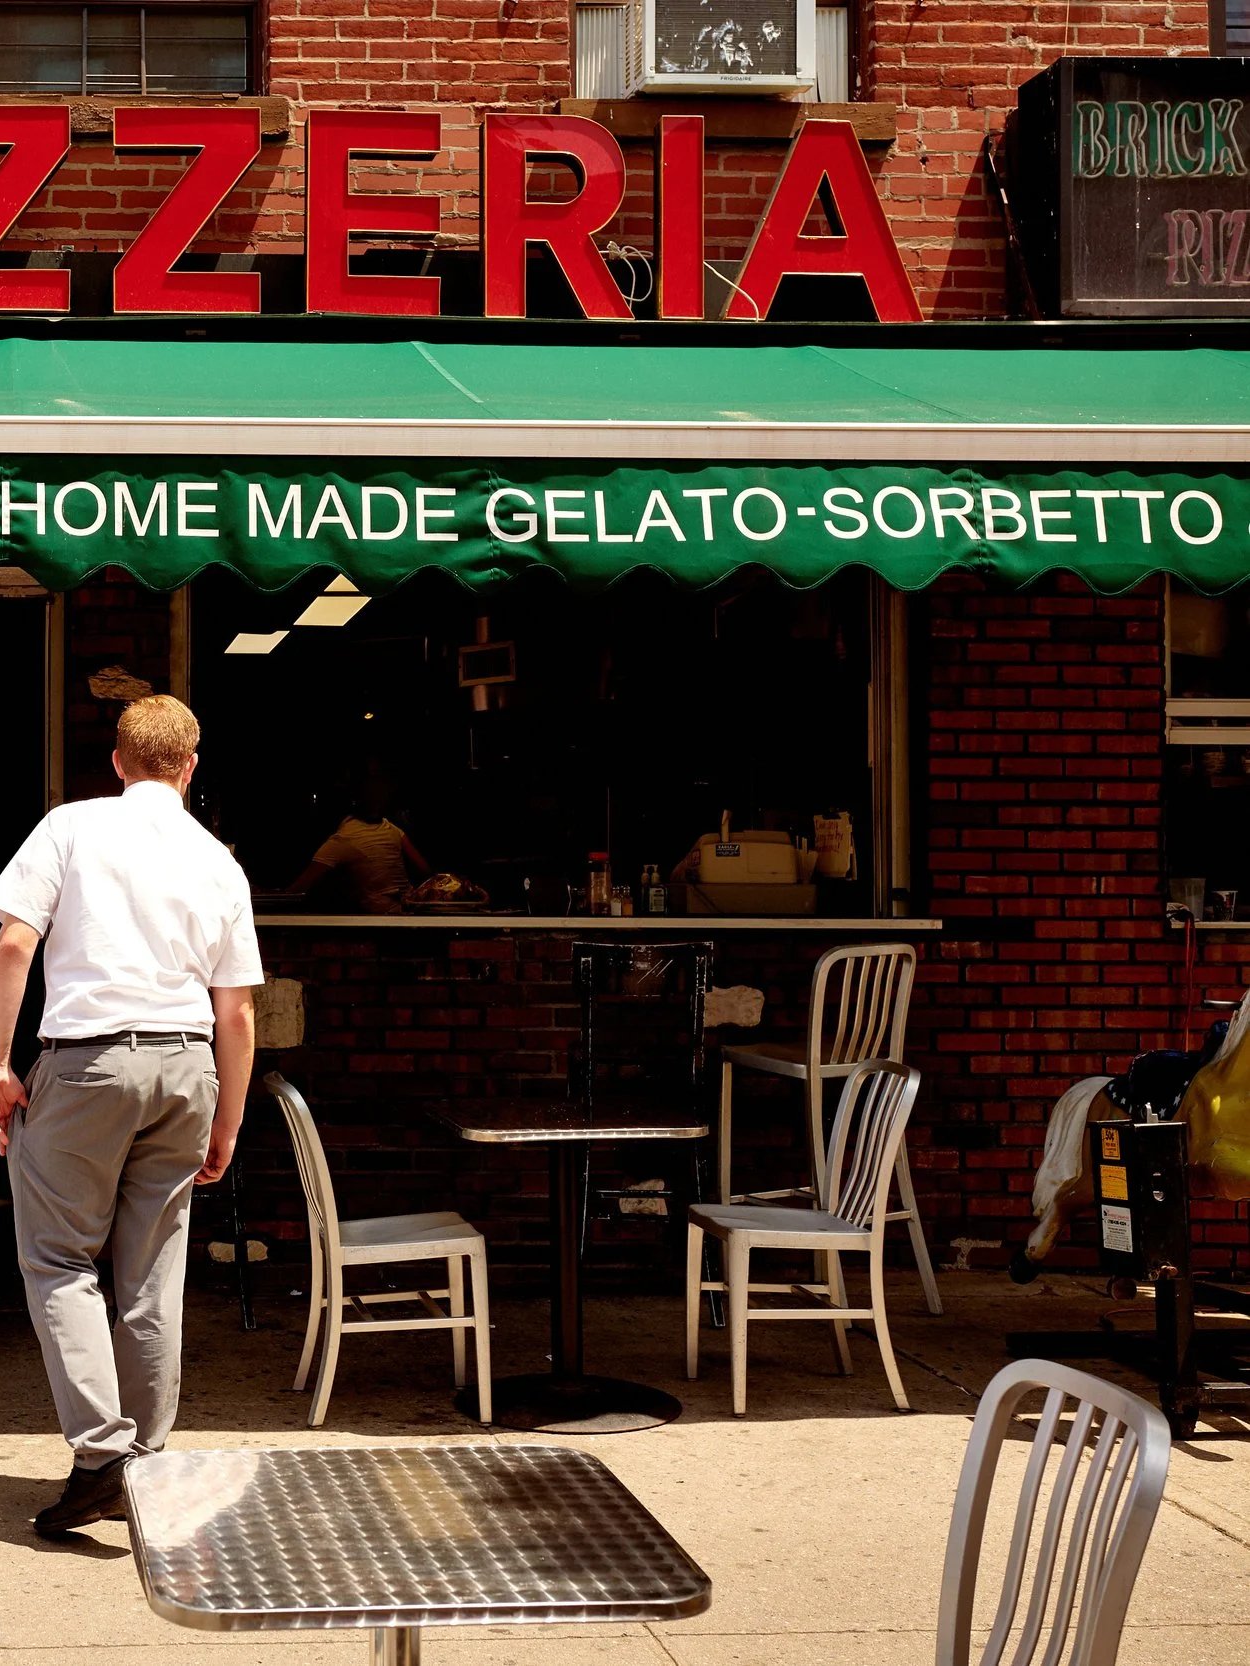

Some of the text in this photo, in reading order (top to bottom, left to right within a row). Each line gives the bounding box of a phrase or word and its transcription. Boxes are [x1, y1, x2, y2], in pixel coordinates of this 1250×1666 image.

[1075, 98, 1249, 178] BRICK
[2, 481, 1222, 544] HOME MADE GELATO-SORBETTO
